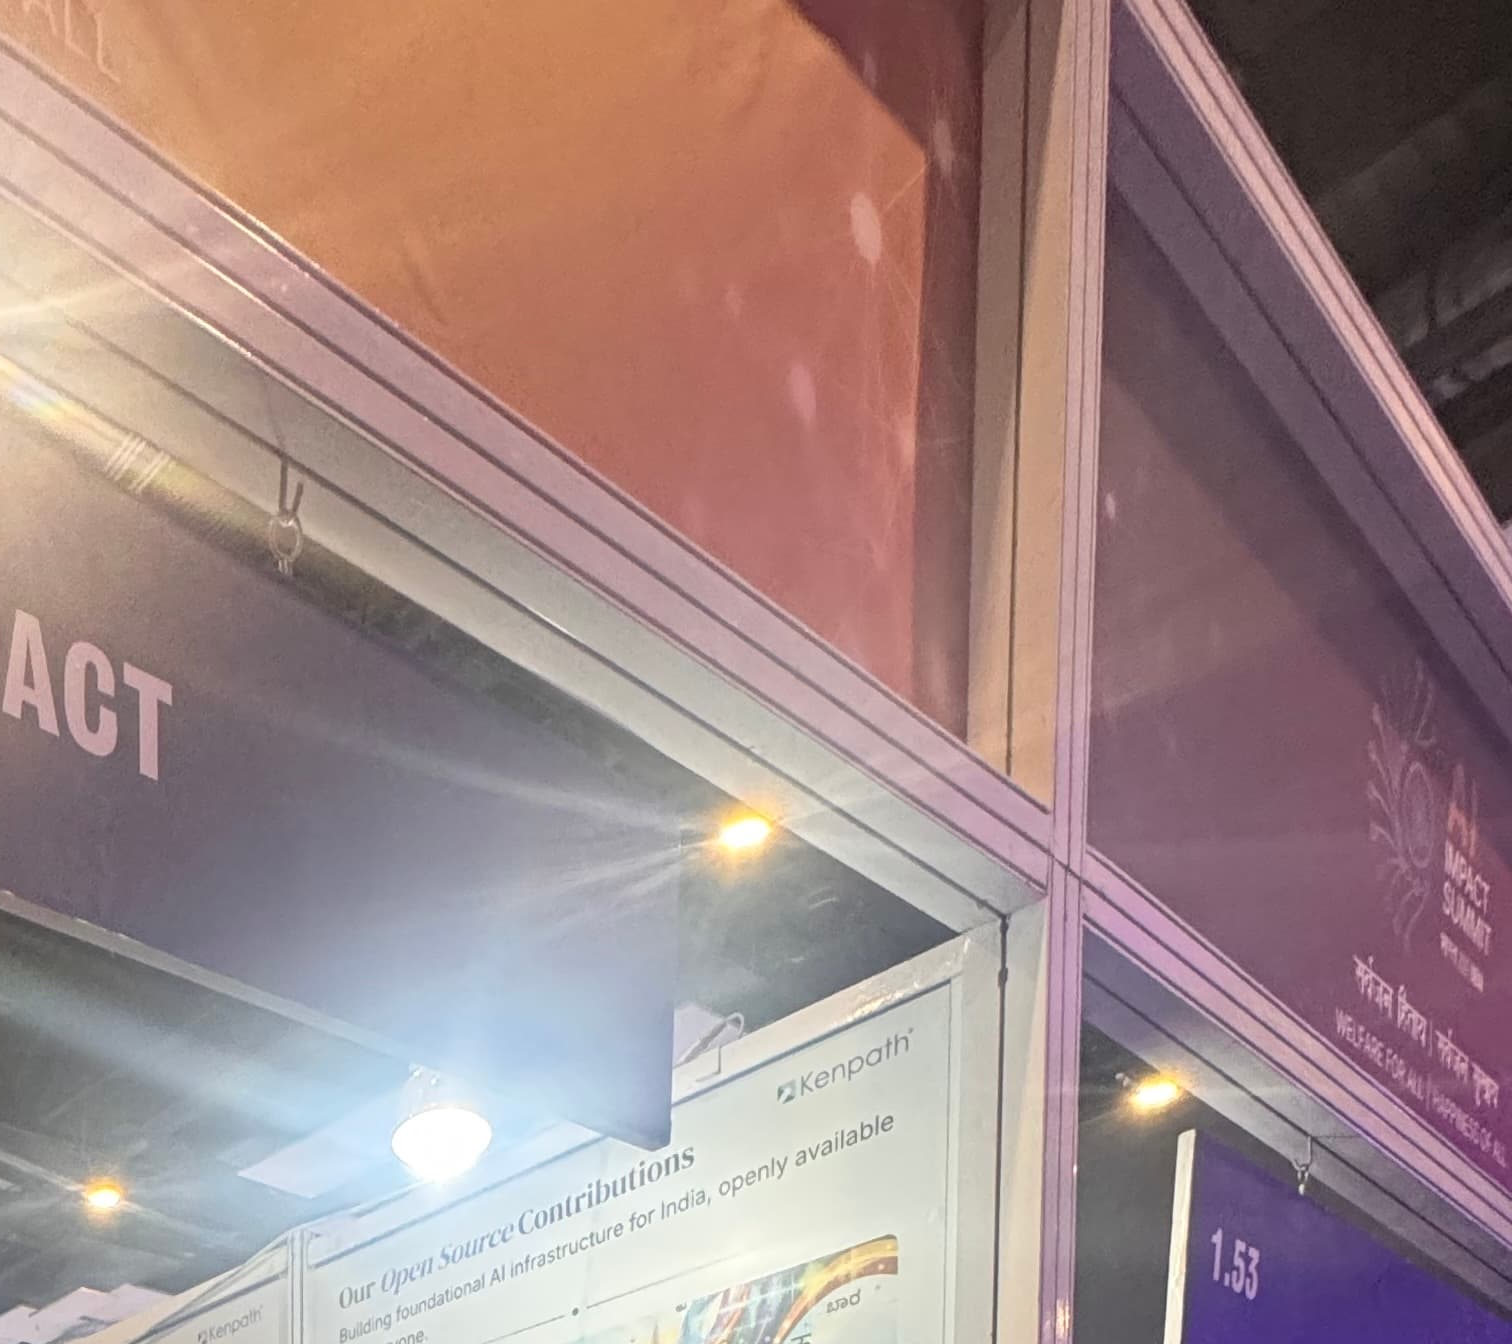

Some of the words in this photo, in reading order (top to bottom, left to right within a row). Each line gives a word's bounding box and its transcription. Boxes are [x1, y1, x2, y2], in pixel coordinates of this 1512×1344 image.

[1445, 840, 1490, 915] IMPACT
[1442, 880, 1491, 955] SUMMIT
[800, 1033, 910, 1097] Kenpath
[1336, 1008, 1385, 1068] WELFARE
[1385, 1048, 1406, 1083] FOR
[1408, 1067, 1424, 1101] ALL
[338, 1278, 378, 1311] Our
[380, 1255, 437, 1295] Open
[438, 1221, 515, 1271] Source
[517, 1145, 696, 1236] Contributions
[338, 1311, 393, 1344] Building
[396, 1273, 487, 1323] foundational
[489, 1266, 507, 1287] AI
[509, 1219, 625, 1277] infrastructure
[628, 1205, 656, 1234] for
[659, 1187, 712, 1220] India,
[718, 1157, 789, 1198] openly
[793, 1112, 895, 1168] available
[1211, 1227, 1260, 1300] 1.53
[208, 1310, 262, 1344] Kenpath
